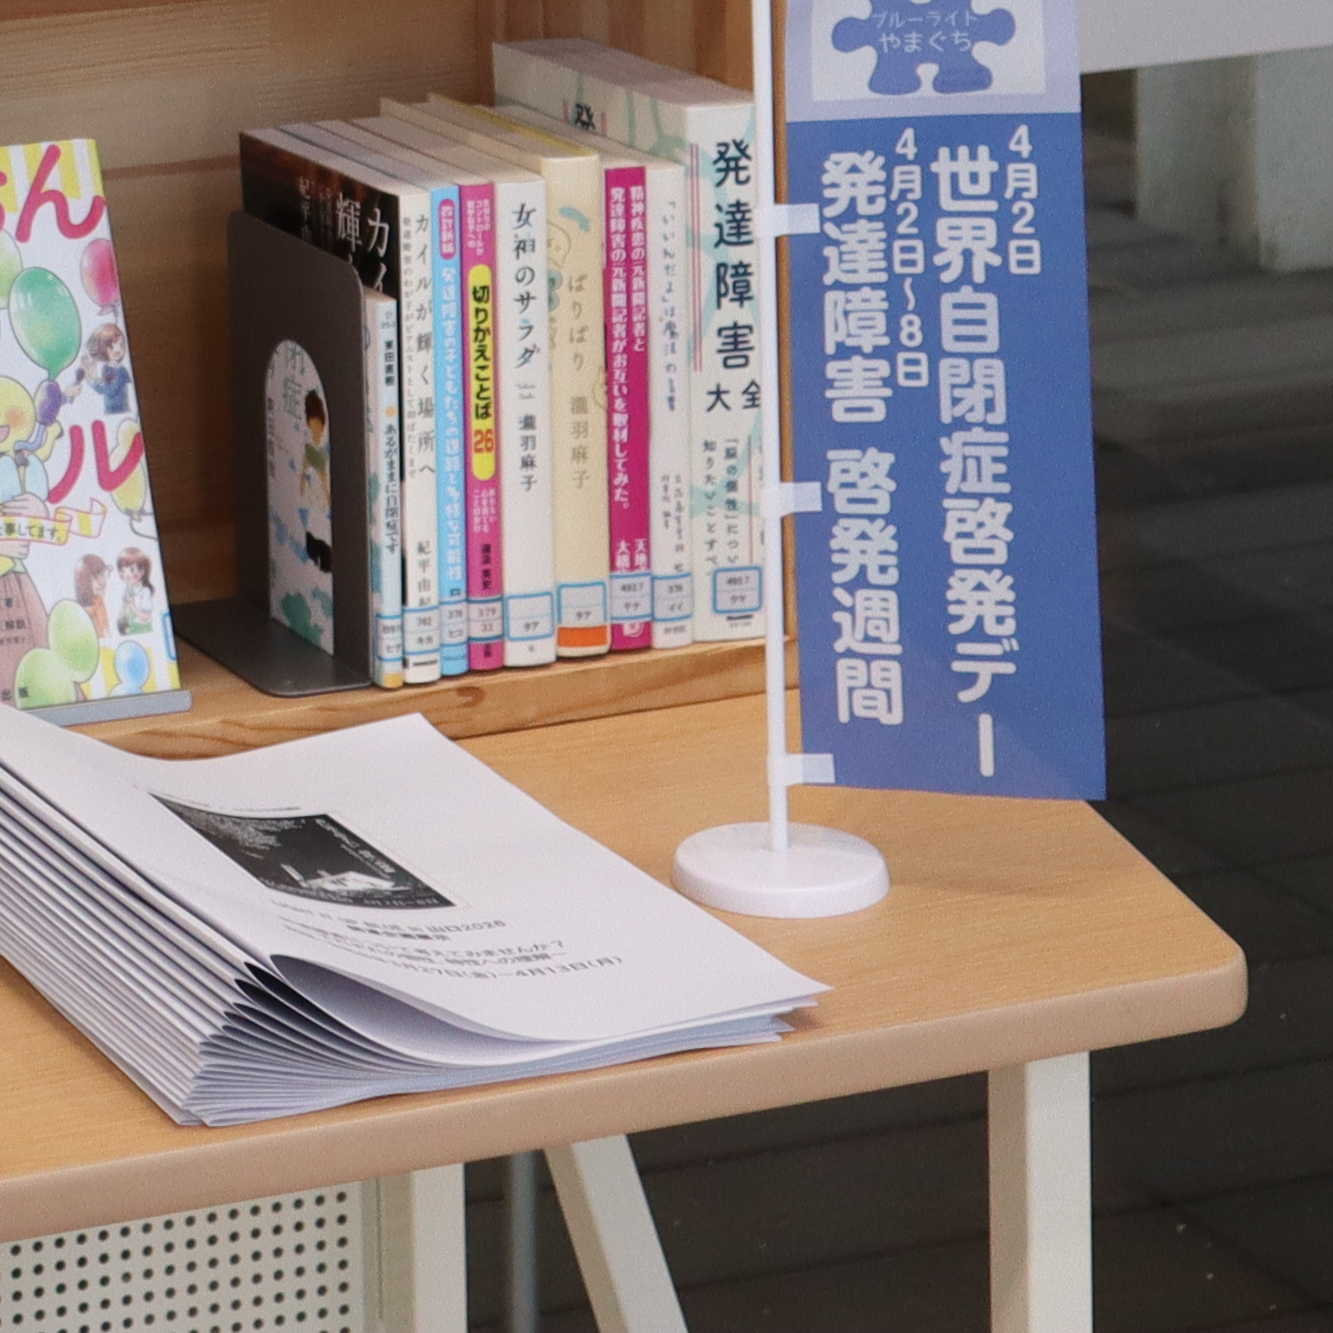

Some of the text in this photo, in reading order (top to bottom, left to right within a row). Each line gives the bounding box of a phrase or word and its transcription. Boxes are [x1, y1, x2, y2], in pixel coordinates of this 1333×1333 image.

[871, 8, 979, 30] ブルーライト
[877, 31, 973, 54] やまぐち
[512, 202, 542, 370] 女神のサラダ
[711, 138, 758, 372] 発達障害
[1003, 125, 1041, 275] 4月2日
[415, 213, 436, 475] カイルが輝く場所へ
[820, 149, 905, 727] 発達障害 啓発週間
[929, 144, 1020, 778] 世界自閉症啓発デー
